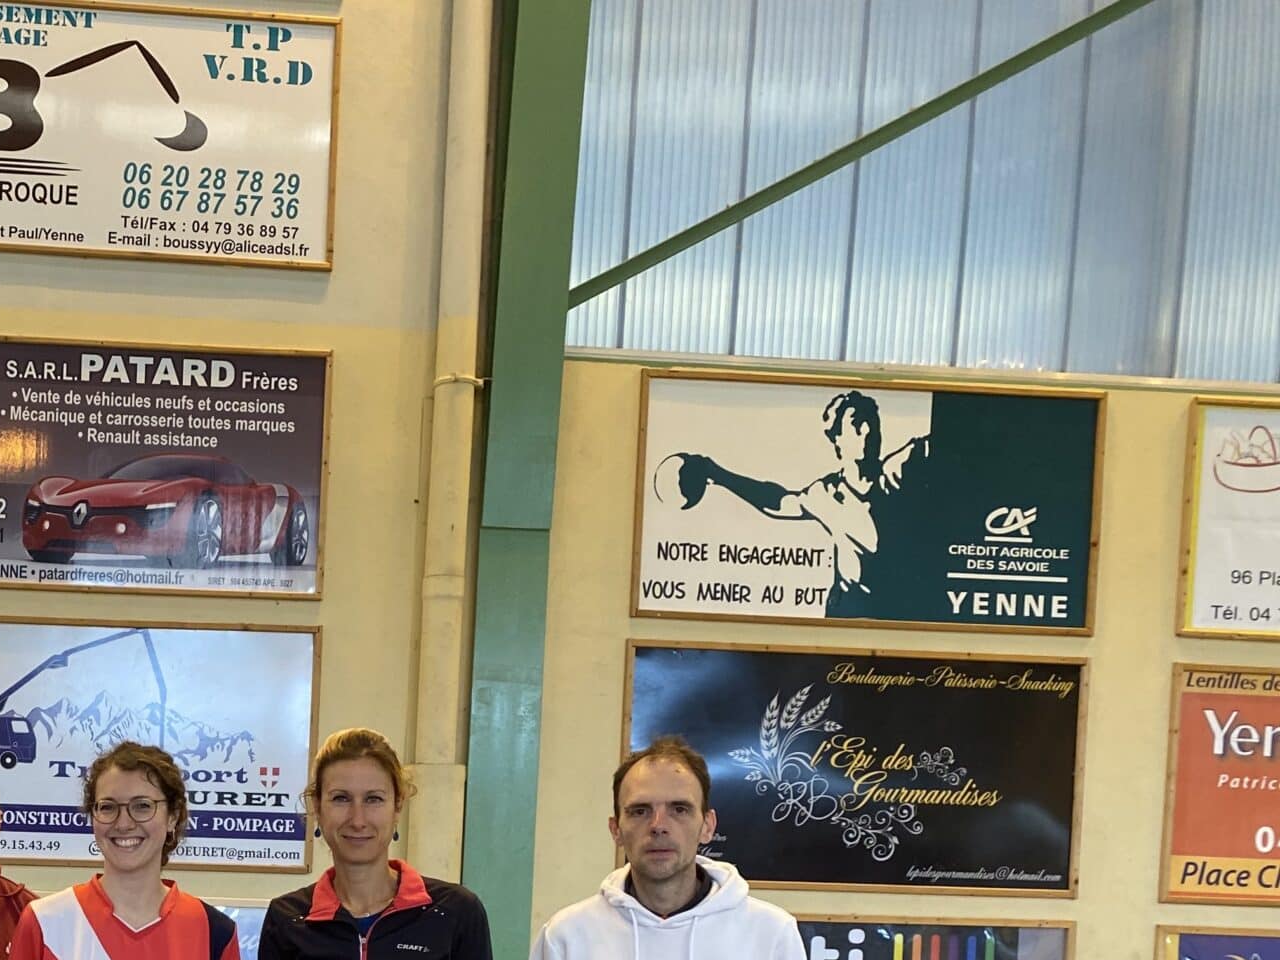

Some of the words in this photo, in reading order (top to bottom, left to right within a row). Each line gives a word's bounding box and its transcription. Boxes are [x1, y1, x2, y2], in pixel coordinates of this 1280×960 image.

[226, 23, 292, 51] T.P
[203, 54, 313, 86] V.R.D
[123, 162, 152, 185] 06
[161, 165, 189, 188] 20
[198, 167, 226, 190] 28
[237, 170, 263, 192] 78
[272, 172, 300, 195] 29
[123, 186, 151, 209] 06
[160, 189, 189, 212] 67
[197, 192, 226, 214] 87
[235, 194, 263, 217] 57
[271, 197, 299, 219] 36
[8, 226, 84, 242] Paul/Yenne
[192, 221, 209, 234] 04
[215, 222, 231, 235] 79
[237, 224, 254, 237] 36
[260, 225, 276, 238] 89
[282, 227, 299, 239] 57
[108, 231, 151, 247] E-mail
[163, 235, 309, 257] boussyy@aliceadsl.fr
[80, 354, 235, 388] PATARD
[242, 371, 298, 391] Frères
[22, 388, 60, 404] Vente
[64, 389, 81, 405] de
[86, 391, 151, 409] véhicules
[156, 394, 194, 410] neufs
[198, 398, 211, 411] et
[215, 399, 285, 414] occasions
[10, 406, 85, 425] Mécanique
[89, 411, 102, 424] et
[106, 411, 184, 428] carrosserie
[188, 415, 231, 430] toutes
[235, 419, 295, 435] marques
[87, 428, 141, 445] Renault
[144, 431, 218, 448] assistance
[657, 541, 708, 562] NOTRE
[719, 544, 824, 567] ENGAGEMENT
[948, 543, 999, 557] CRÉDIT
[1000, 547, 1070, 559] AGRICOLE
[39, 568, 183, 586] patardfreres@hotmail.fr
[967, 559, 994, 570] DES
[998, 561, 1050, 572] SAVOIE
[1231, 570, 1252, 584] 96
[642, 579, 686, 600] VOUS
[696, 582, 751, 603] MENER
[761, 585, 784, 604] AU
[795, 588, 827, 606] BUT
[947, 591, 1068, 618] YENNE
[1210, 605, 1242, 620] Tél.
[1249, 607, 1270, 621] 04
[1186, 672, 1257, 690] Lentilles
[882, 744, 914, 770] des
[840, 769, 1003, 812] Gourmandises
[213, 818, 295, 834] POMPAGE
[1180, 861, 1250, 887] Place
